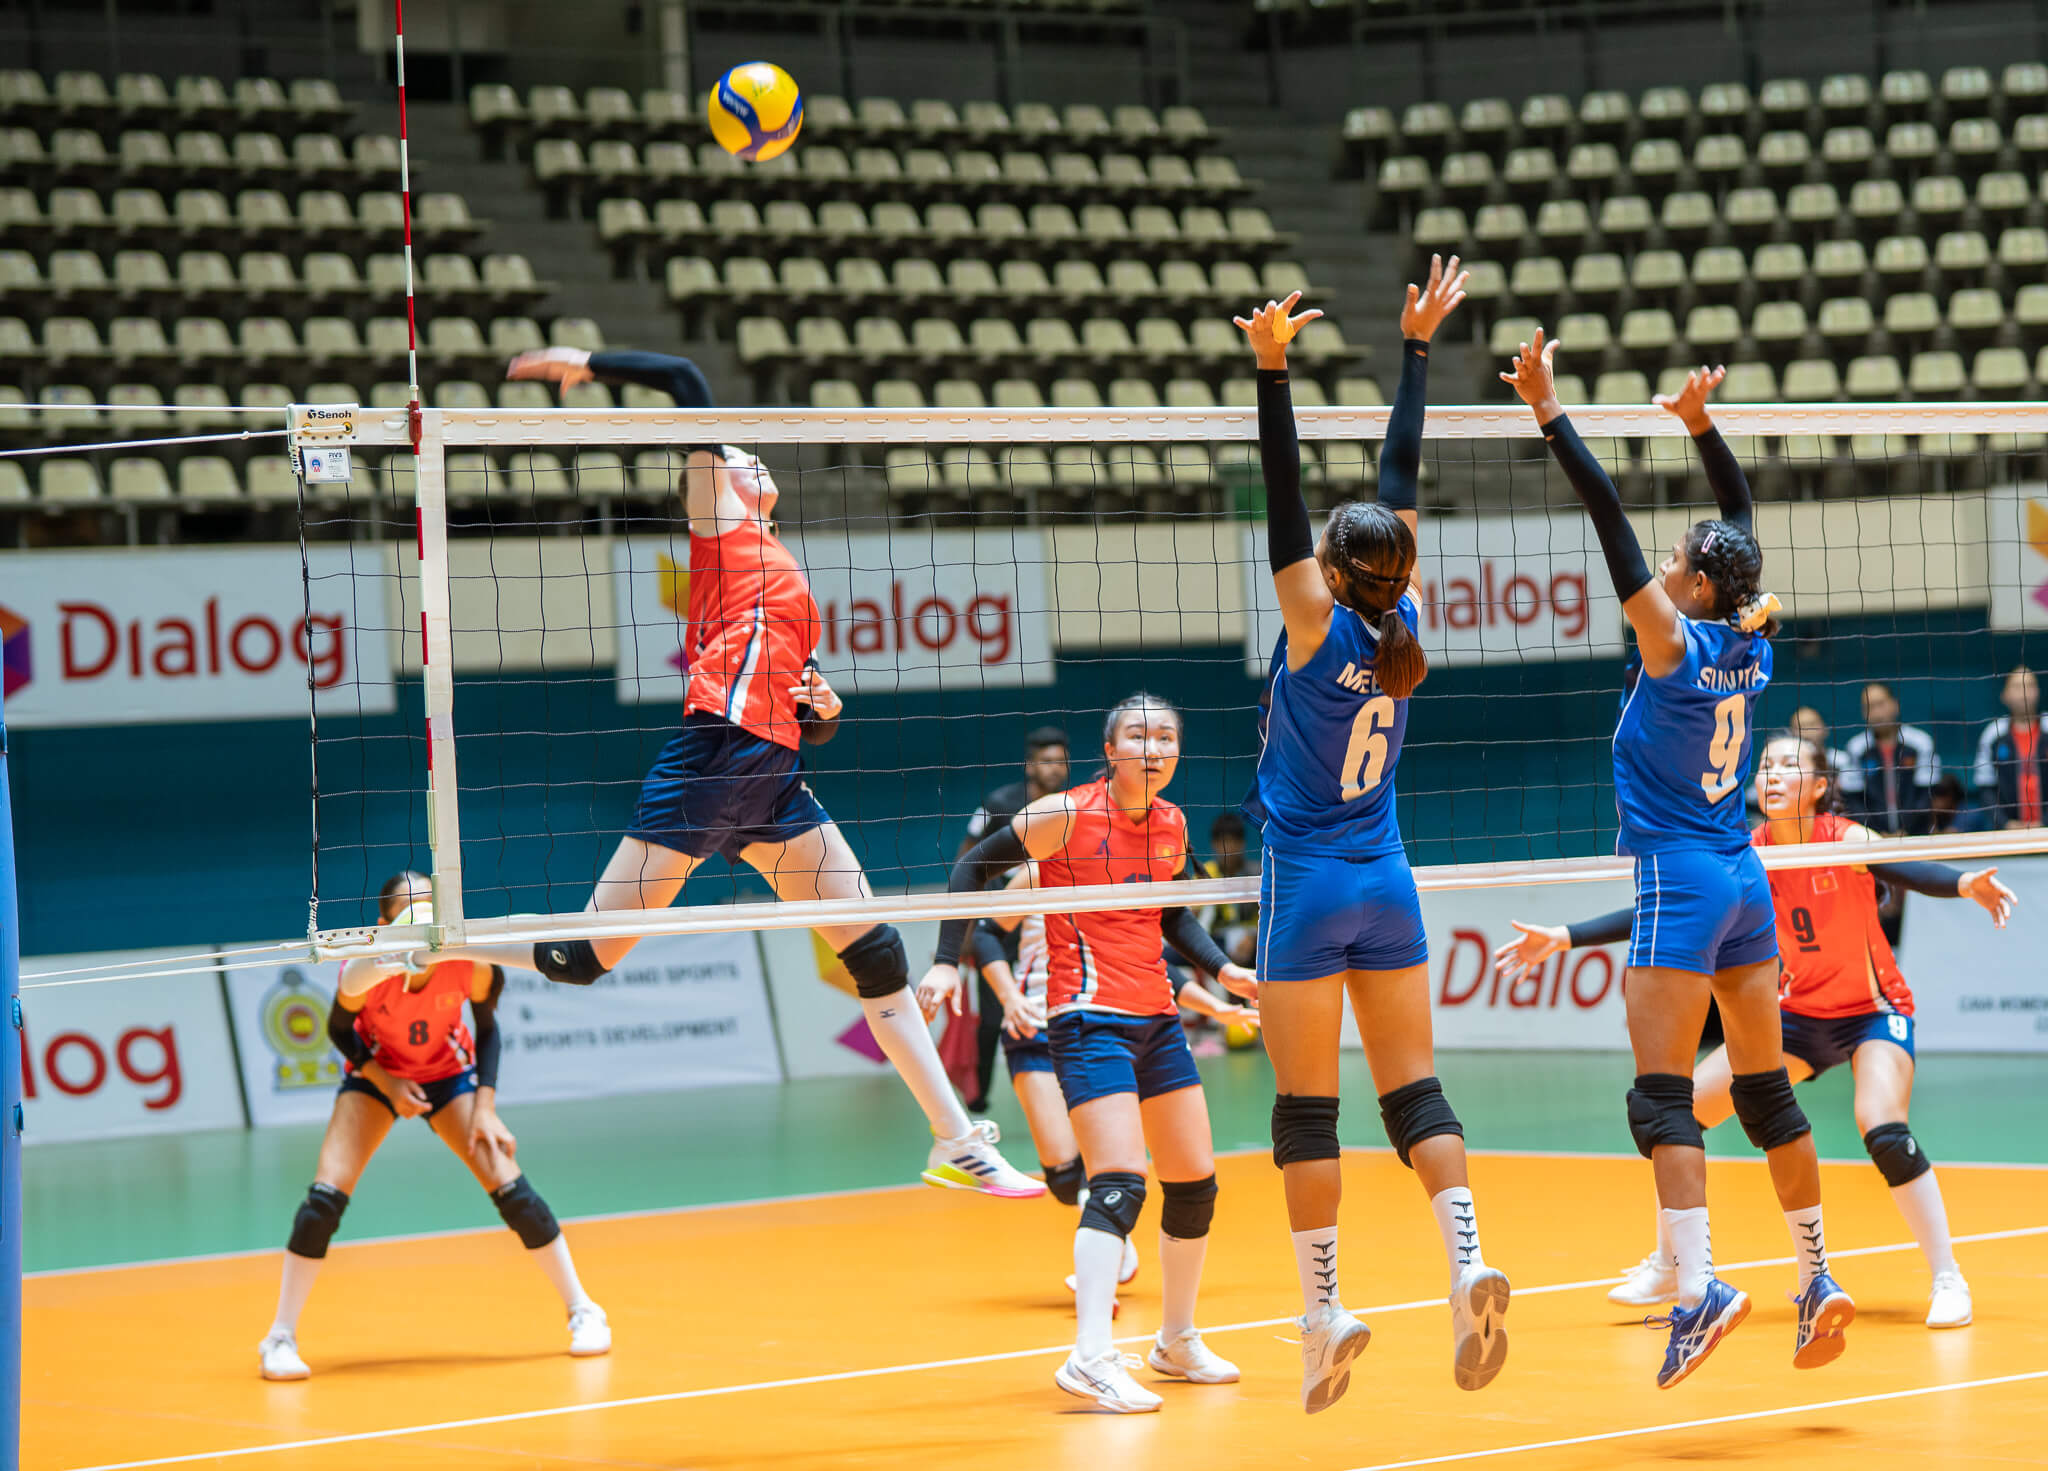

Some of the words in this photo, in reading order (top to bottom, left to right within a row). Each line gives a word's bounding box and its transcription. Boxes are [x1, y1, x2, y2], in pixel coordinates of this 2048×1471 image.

[317, 410, 352, 419] Senoh
[1426, 560, 1588, 640] ialog
[821, 579, 1013, 666] ialog
[57, 594, 348, 690] Dialog
[1697, 662, 1769, 693] SUNITA
[1340, 696, 1395, 802] 6
[1701, 693, 1746, 805] 9
[1791, 907, 1816, 944] 9
[666, 961, 740, 982] SPORTS
[409, 1020, 429, 1046] 8
[603, 1017, 738, 1043] DEVELOPMENT
[1888, 1014, 1908, 1041] 9
